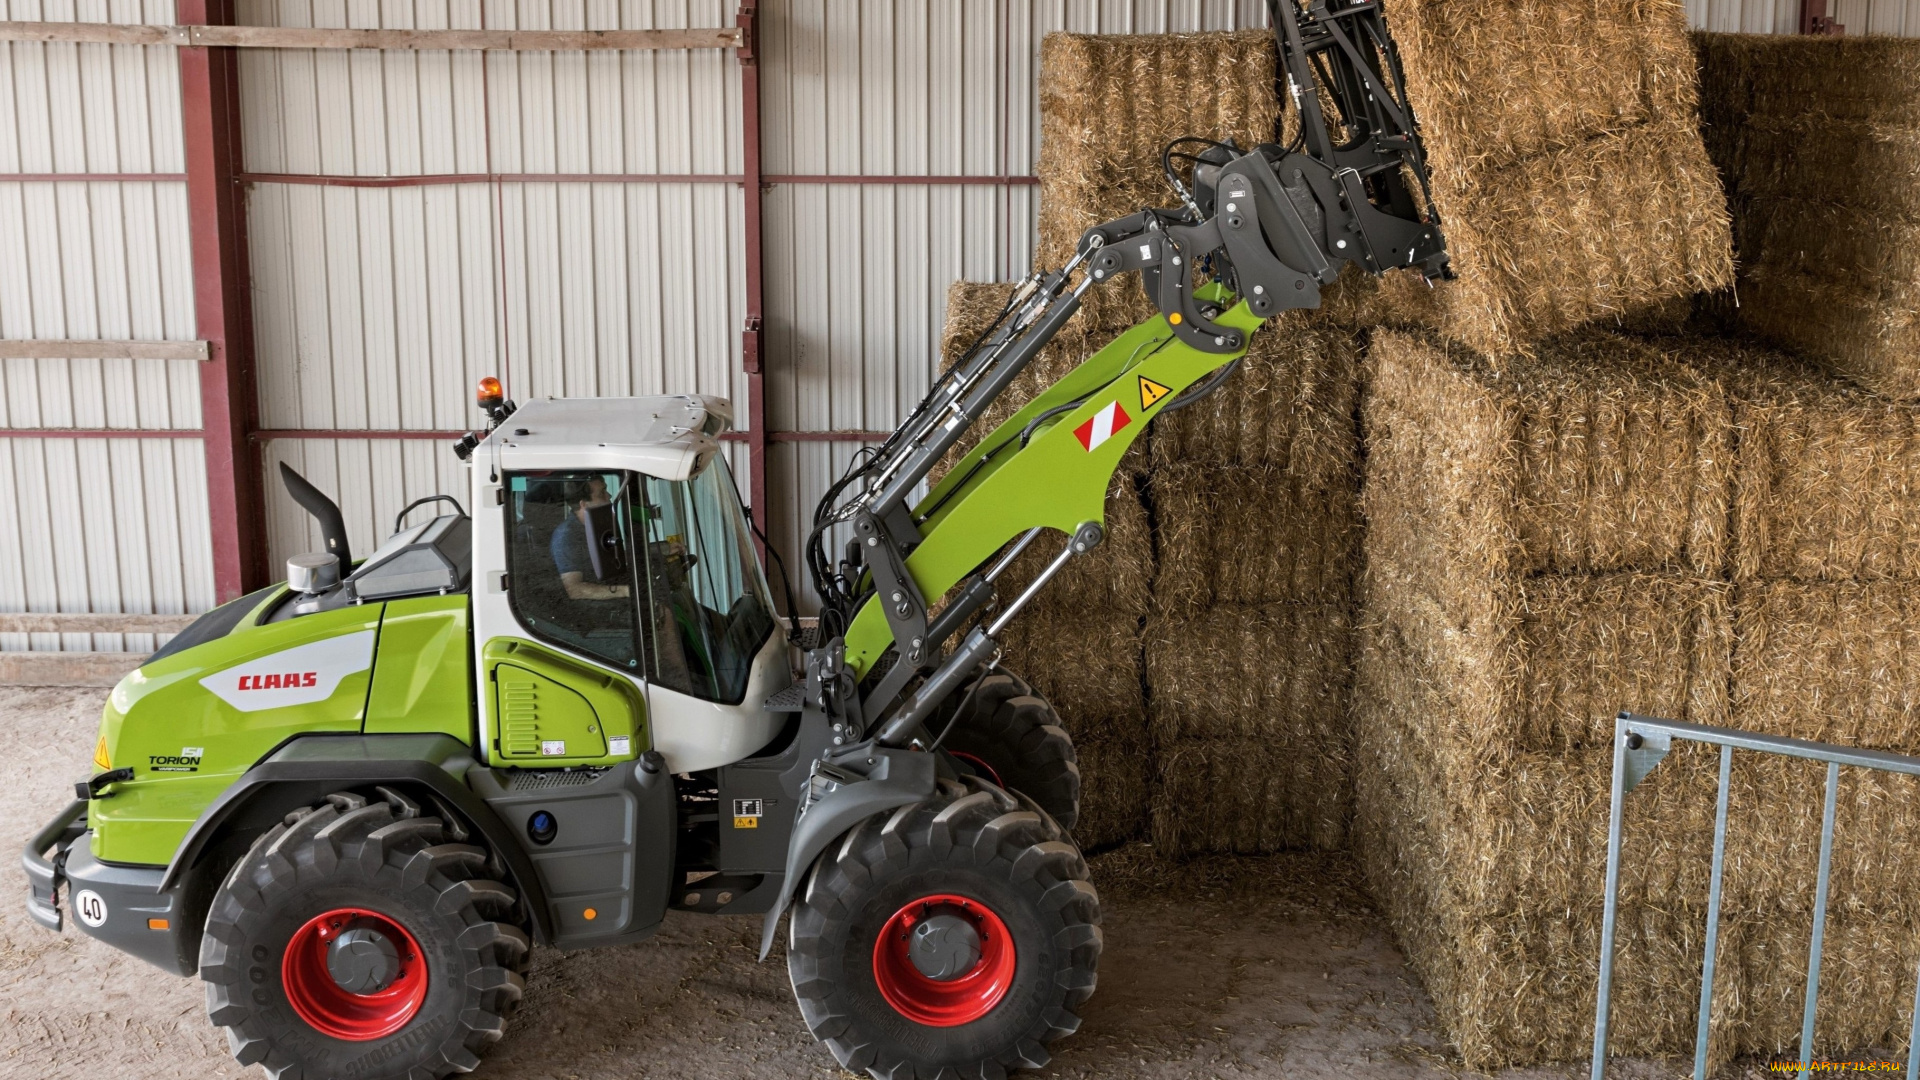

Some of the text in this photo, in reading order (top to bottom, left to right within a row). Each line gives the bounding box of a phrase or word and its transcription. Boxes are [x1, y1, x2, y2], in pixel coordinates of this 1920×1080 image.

[238, 672, 317, 690] CLAAS
[149, 756, 201, 765] TORION
[83, 896, 101, 920] 40
[250, 944, 286, 1025] 2000
